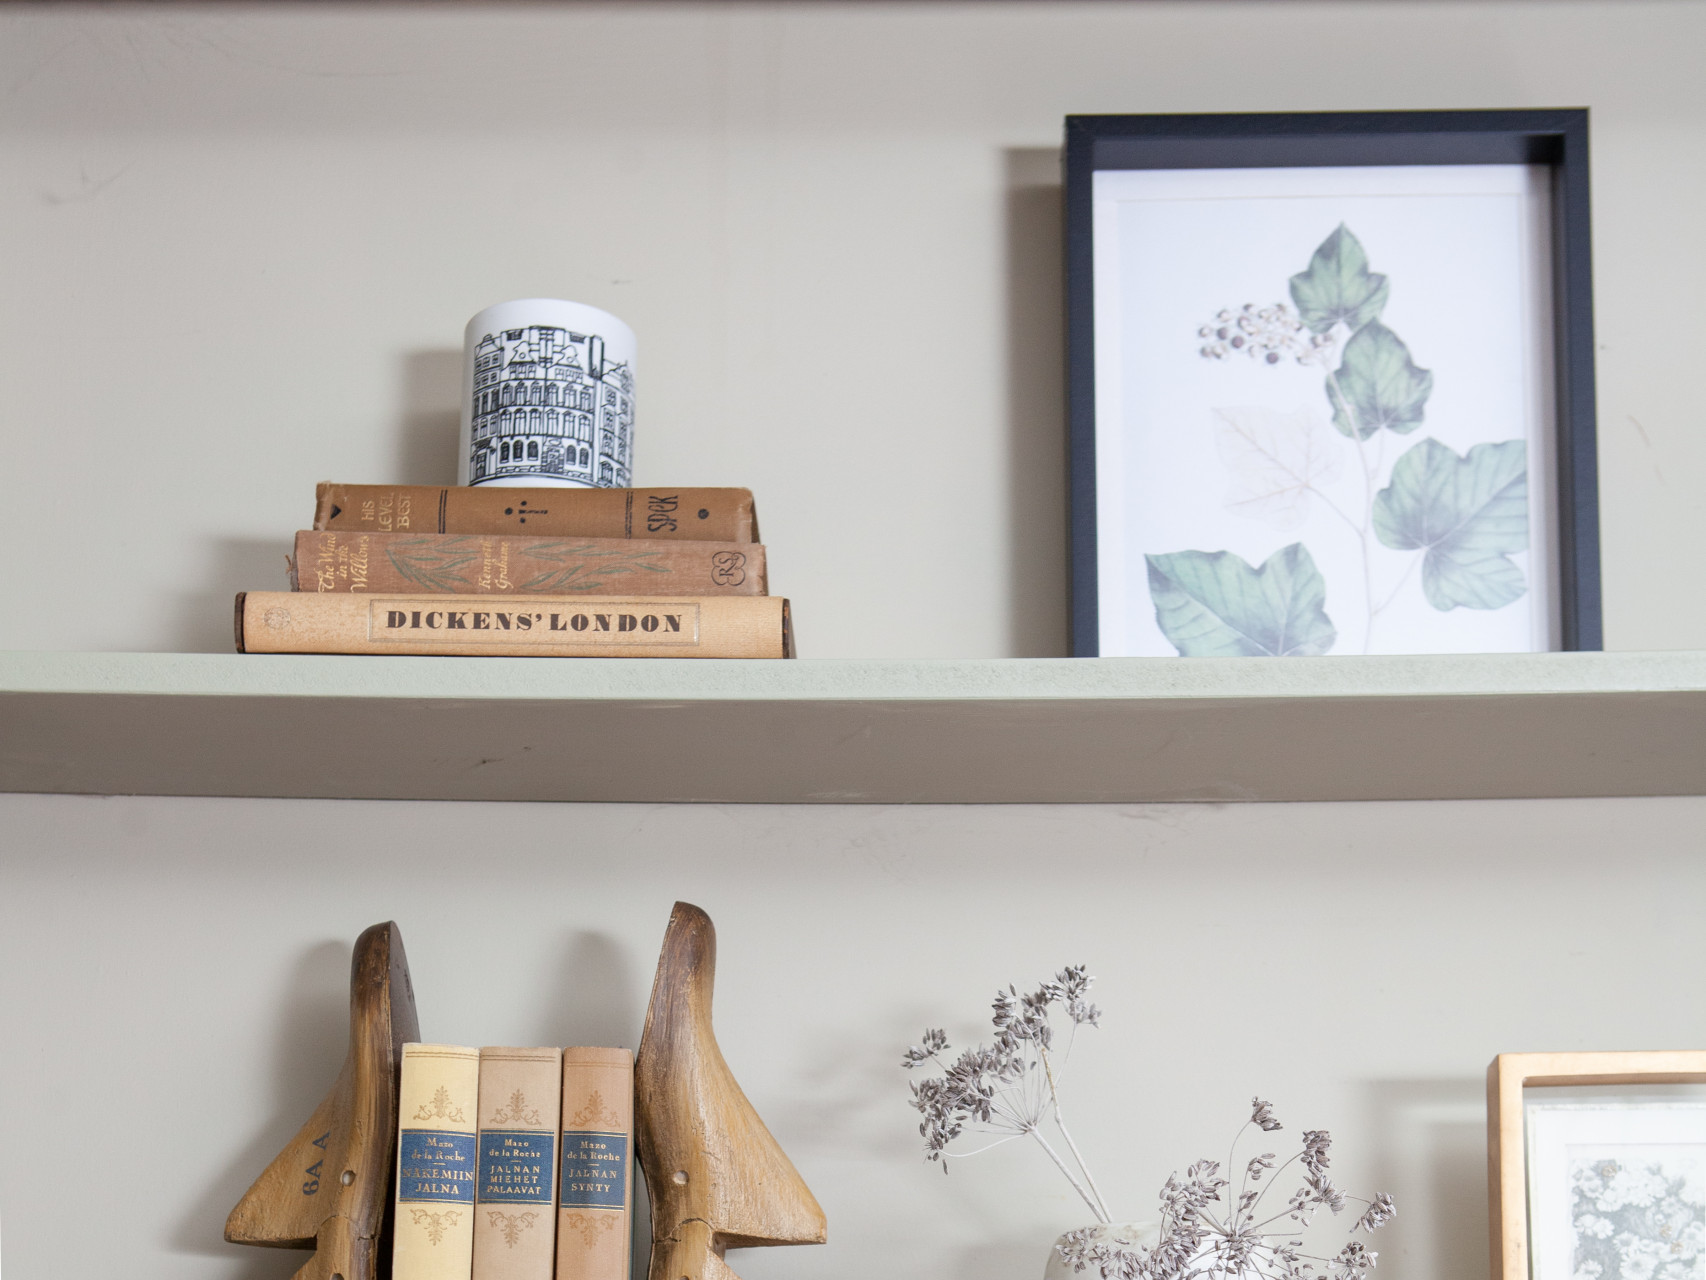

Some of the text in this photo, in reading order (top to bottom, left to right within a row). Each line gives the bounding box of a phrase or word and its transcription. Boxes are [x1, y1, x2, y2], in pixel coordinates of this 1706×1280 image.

[361, 500, 375, 521] HIS
[378, 492, 395, 532] LEVEL
[397, 493, 411, 529] BEST
[314, 532, 336, 593] The Wind
[350, 535, 370, 593] Willows
[479, 540, 492, 590] Kenneth
[492, 541, 514, 590] Grahame
[337, 565, 348, 580] in
[385, 610, 682, 633] DICKENS' LONDON
[504, 1138, 529, 1148] Mazo
[580, 1141, 607, 1150] Mazo
[411, 1149, 465, 1161] de la Roche
[489, 1148, 541, 1158] de la Roche
[567, 1151, 620, 1161] de la Roche
[490, 1165, 540, 1174] JALNAN
[568, 1168, 618, 1179] JALNAN
[490, 1175, 538, 1184] MIEHET
[415, 1182, 460, 1195] JALNA
[486, 1185, 542, 1195] PALAAVAT
[571, 1183, 611, 1193] SYNTY
